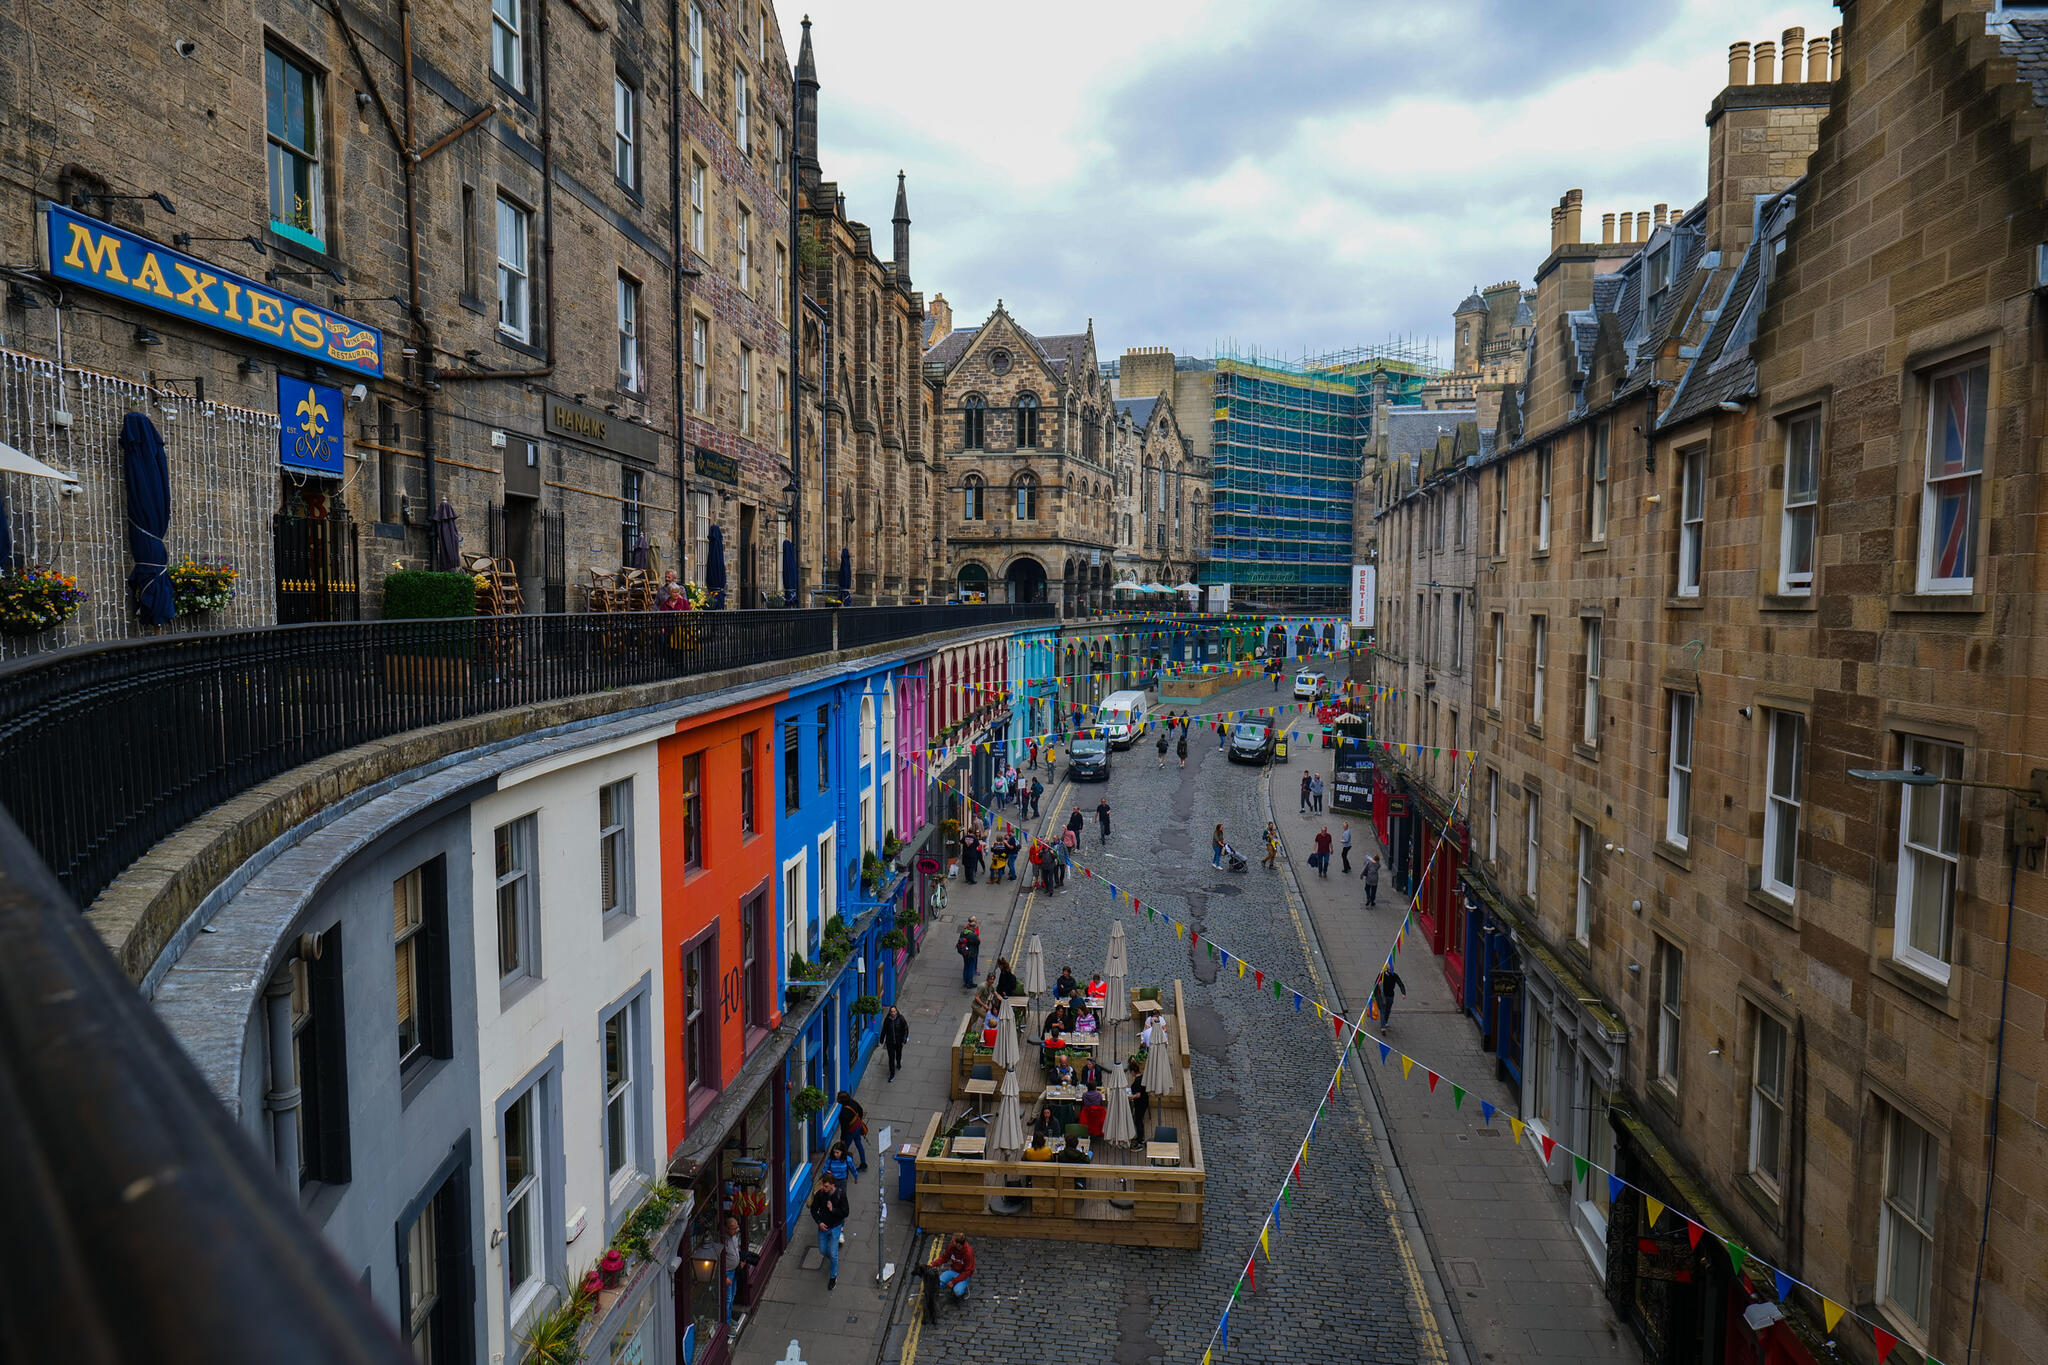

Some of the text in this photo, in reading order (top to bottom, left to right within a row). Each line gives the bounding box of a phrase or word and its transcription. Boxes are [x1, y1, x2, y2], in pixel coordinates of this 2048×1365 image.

[63, 220, 325, 349] MAXIES
[326, 323, 349, 333] BISTRO
[344, 332, 373, 346] WINE BAR
[331, 348, 374, 360] RESTAURANT
[554, 405, 608, 440] HANAMS
[286, 426, 299, 435] EST.
[1337, 784, 1368, 794] BEER GARDEN
[1339, 794, 1352, 802] OPEN
[720, 966, 739, 1024] 40
